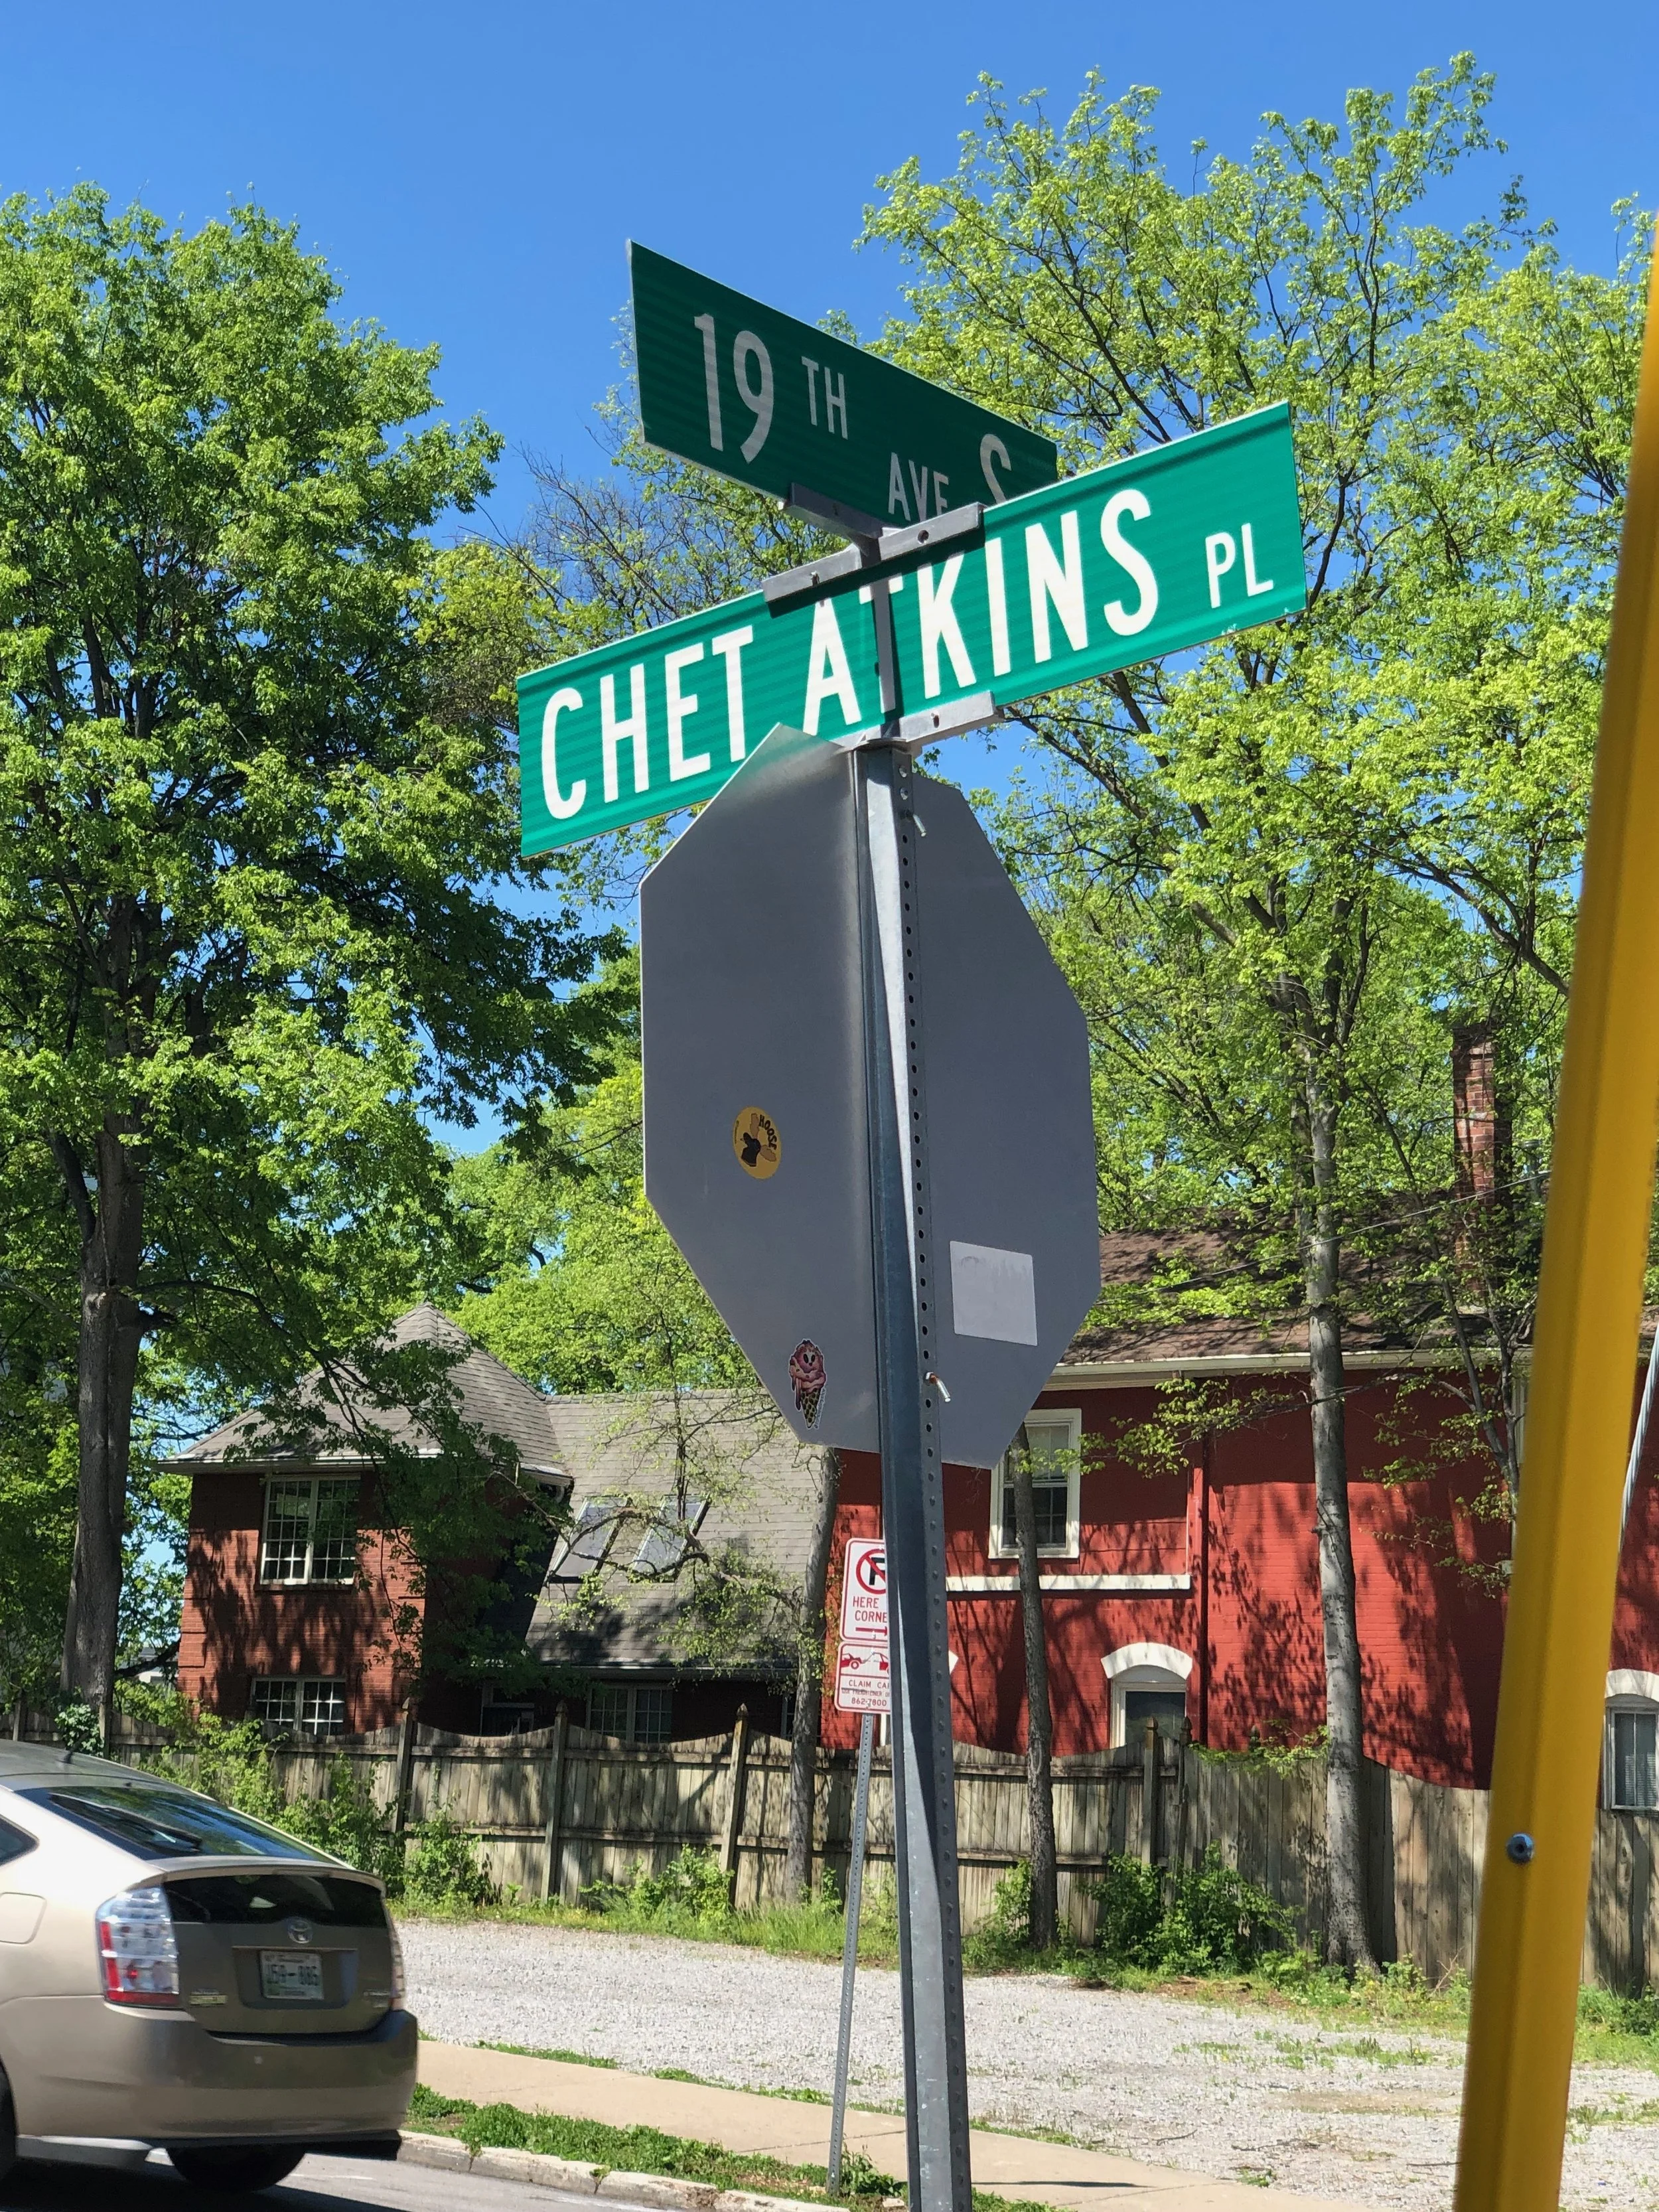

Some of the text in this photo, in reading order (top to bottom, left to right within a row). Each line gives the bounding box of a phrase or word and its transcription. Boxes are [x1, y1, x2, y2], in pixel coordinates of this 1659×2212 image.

[694, 313, 774, 464] 19
[801, 356, 848, 439] TH
[540, 489, 1274, 820] CHET ATKINS PL
[853, 1596, 879, 1609] HERE
[855, 1610, 888, 1623] CORNE
[849, 1679, 871, 1688] CLAIM
[851, 1697, 887, 1706] 862-7800
